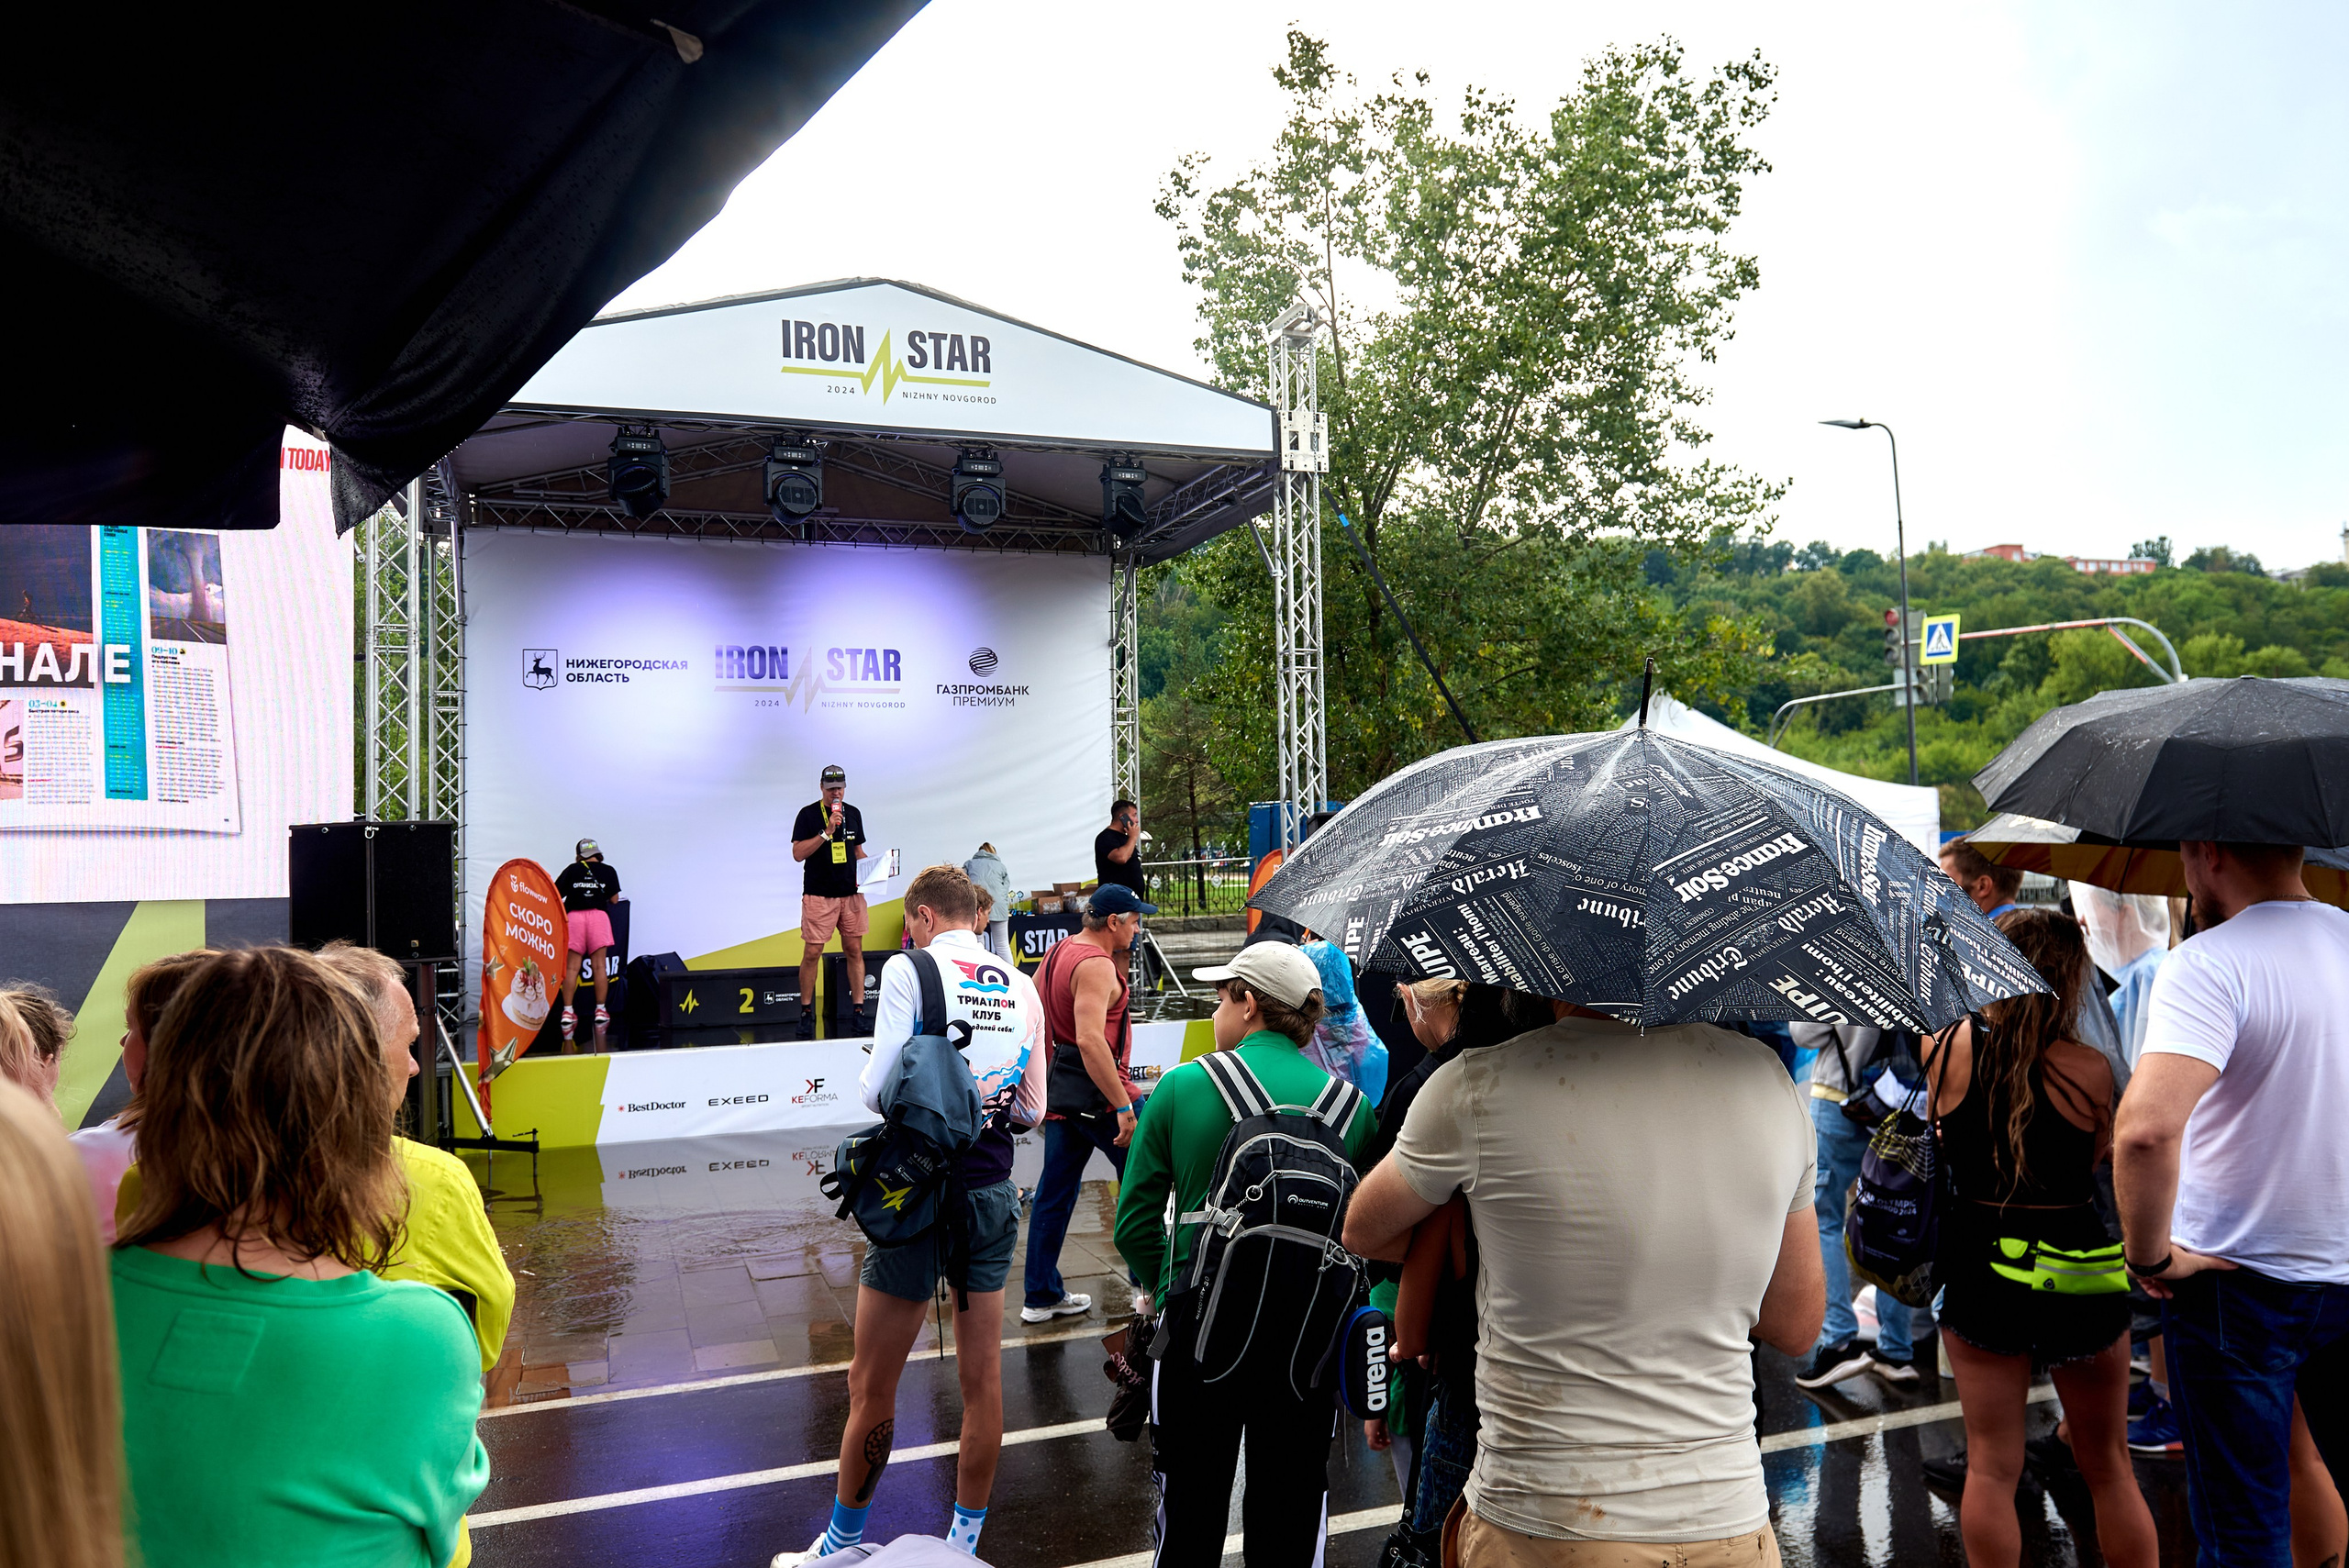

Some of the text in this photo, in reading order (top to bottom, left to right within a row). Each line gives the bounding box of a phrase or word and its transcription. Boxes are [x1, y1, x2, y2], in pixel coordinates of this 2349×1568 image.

[782, 319, 991, 373] IRON STAR
[827, 385, 996, 405] 2024 NIZHNY NOVGOROD
[287, 448, 330, 472] TODAY
[565, 658, 688, 671] НИЖЕГОРОДСКАЯ
[715, 645, 901, 682] IRON STAR
[565, 673, 630, 683] ОБЛАСТЬ
[936, 684, 1030, 695] ГАЗПРОМБАНК
[755, 699, 780, 707] 2024
[857, 701, 906, 709] NOVGOROD
[953, 696, 1015, 706] ПРЕМИУМ
[1449, 858, 1532, 895] Herald
[1500, 891, 1530, 921] suspend
[509, 902, 552, 936] СКОРО
[506, 921, 555, 960] МОЖНО
[1525, 921, 1542, 941] Golfe
[1541, 942, 1550, 951] du
[1834, 928, 1879, 959] suspend
[1457, 933, 1500, 984] Marreau
[1548, 953, 1564, 973] crise
[739, 988, 754, 1013] 2
[957, 995, 1015, 1008] ТРИАТЛОН
[1824, 975, 1895, 1029] Marreau
[973, 1010, 1001, 1020] КЛУБ
[628, 1101, 686, 1112] BestDoctor
[708, 1094, 769, 1106] EXEED
[791, 1093, 839, 1105] KEFORMA
[1366, 1325, 1386, 1412] arena
